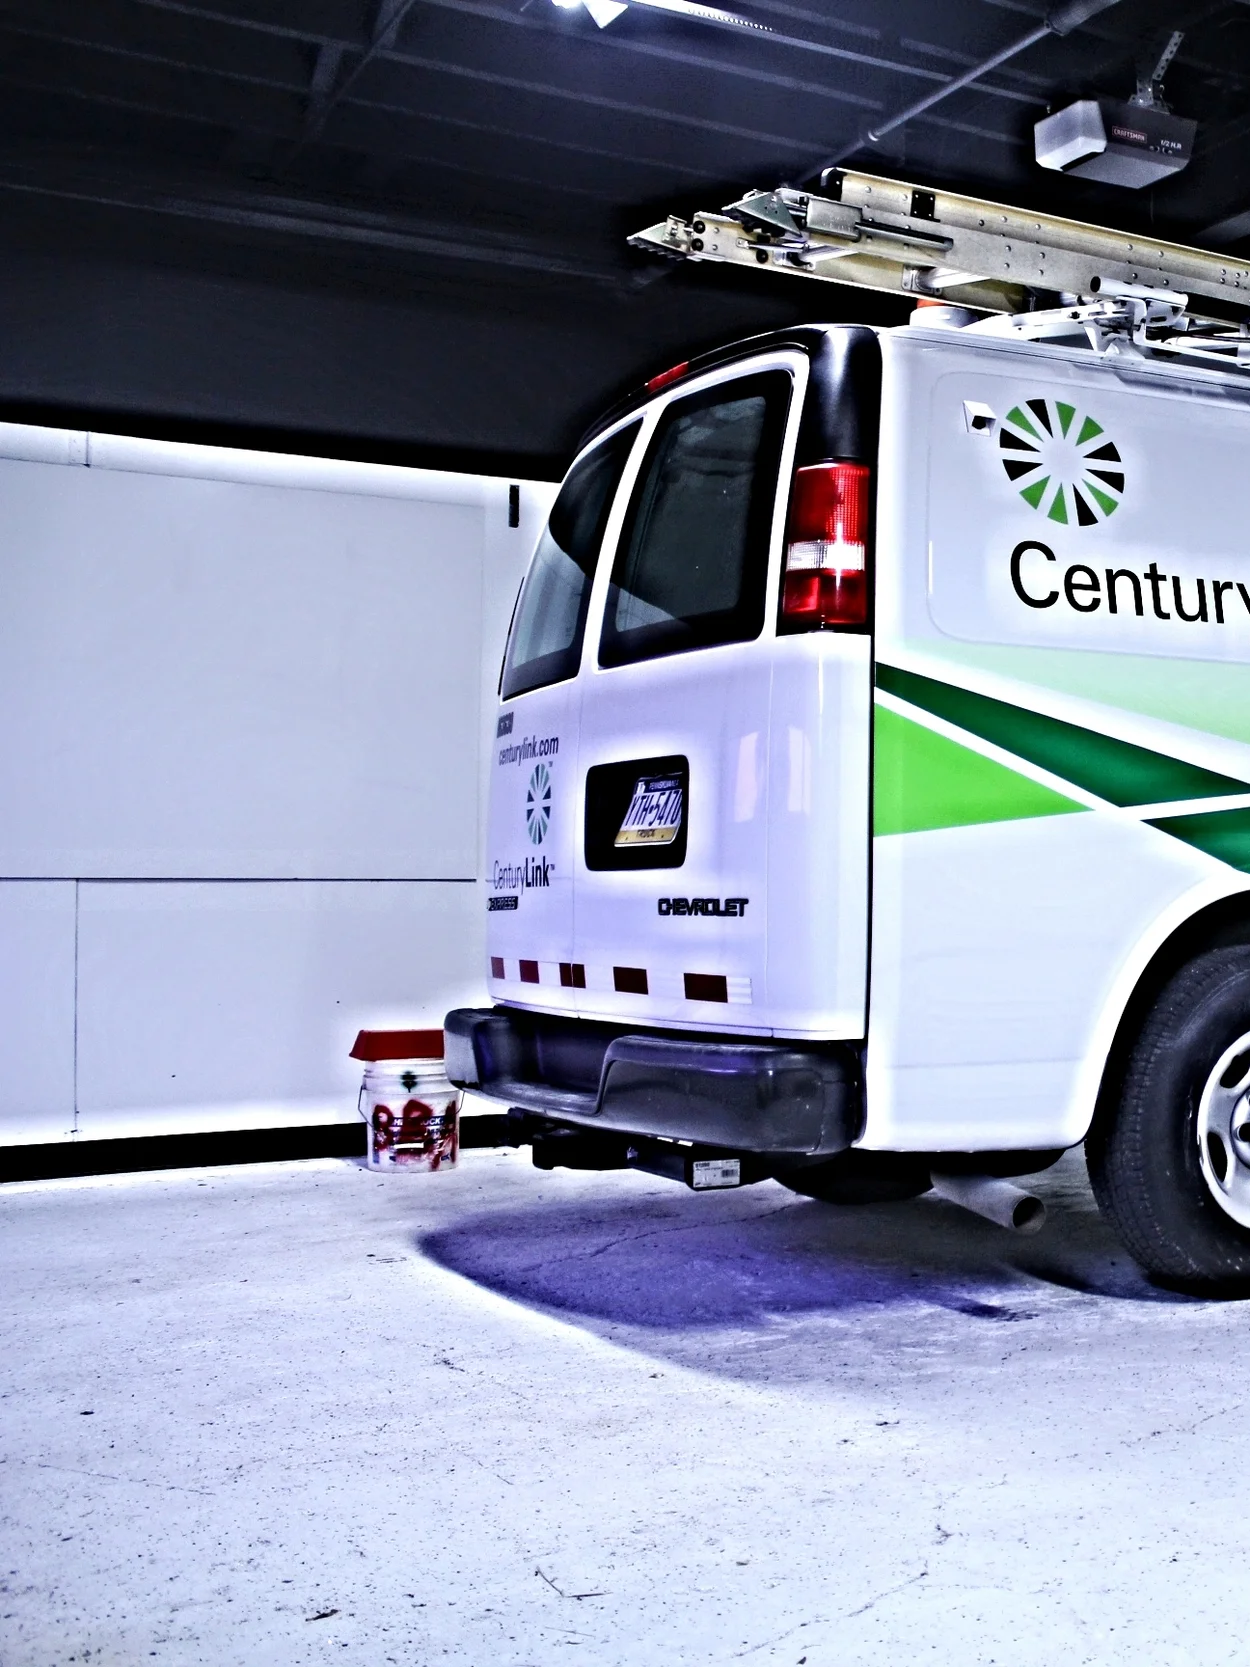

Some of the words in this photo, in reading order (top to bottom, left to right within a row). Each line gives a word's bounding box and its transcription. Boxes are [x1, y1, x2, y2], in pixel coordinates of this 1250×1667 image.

[1113, 128, 1145, 141] CRAFTSMAN
[499, 735, 559, 766] centurylink.com
[494, 855, 550, 895] CenturyLink
[657, 897, 749, 917] CHEVROLET
